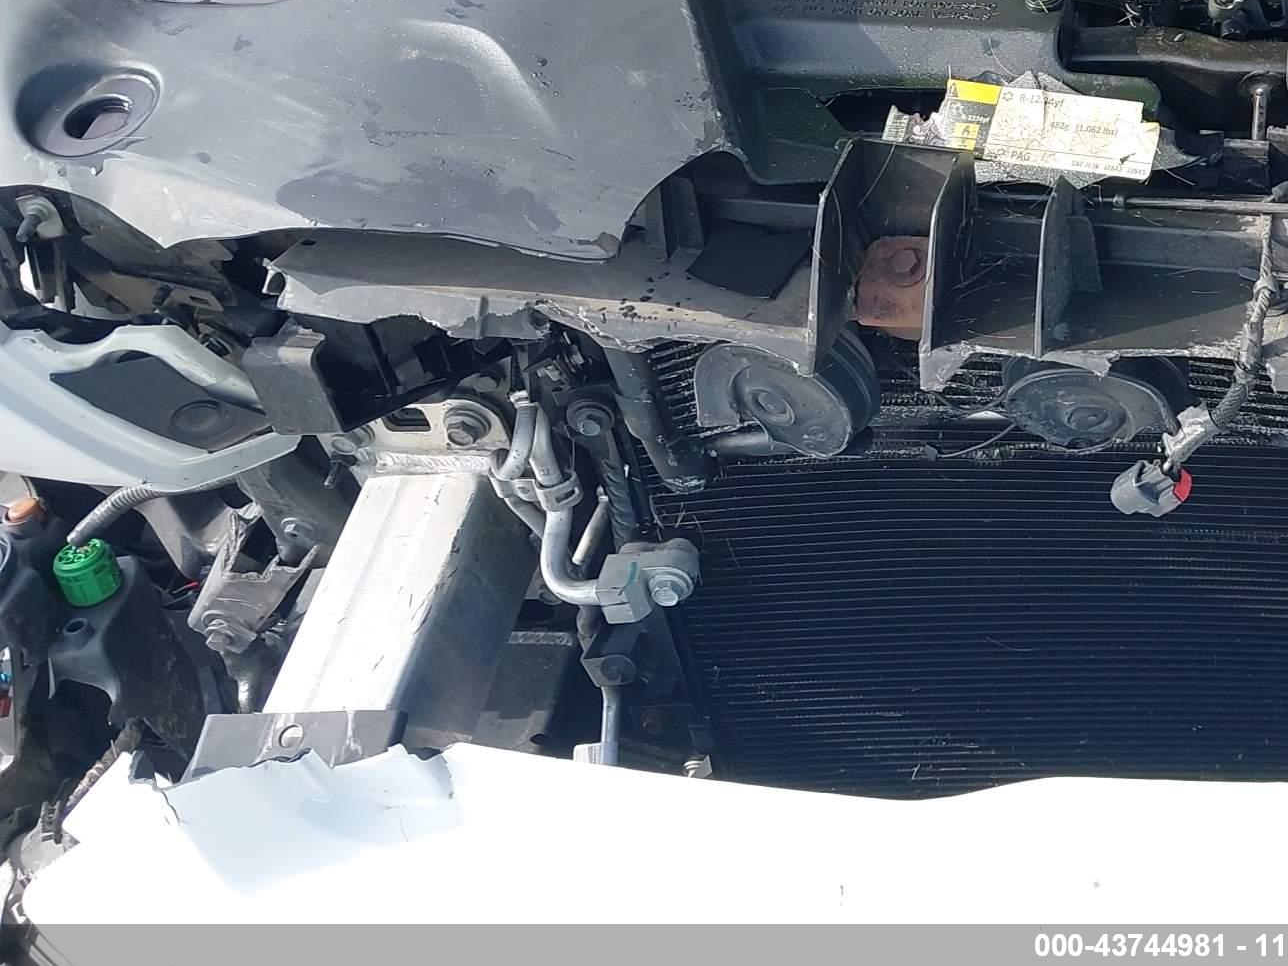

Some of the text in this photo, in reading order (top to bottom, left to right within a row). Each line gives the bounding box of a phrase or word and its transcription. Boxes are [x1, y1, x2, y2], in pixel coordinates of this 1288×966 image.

[903, 0, 928, 8] FOR
[867, 8, 888, 16] ON
[889, 9, 923, 18] SOME
[1010, 150, 1032, 162] PAG
